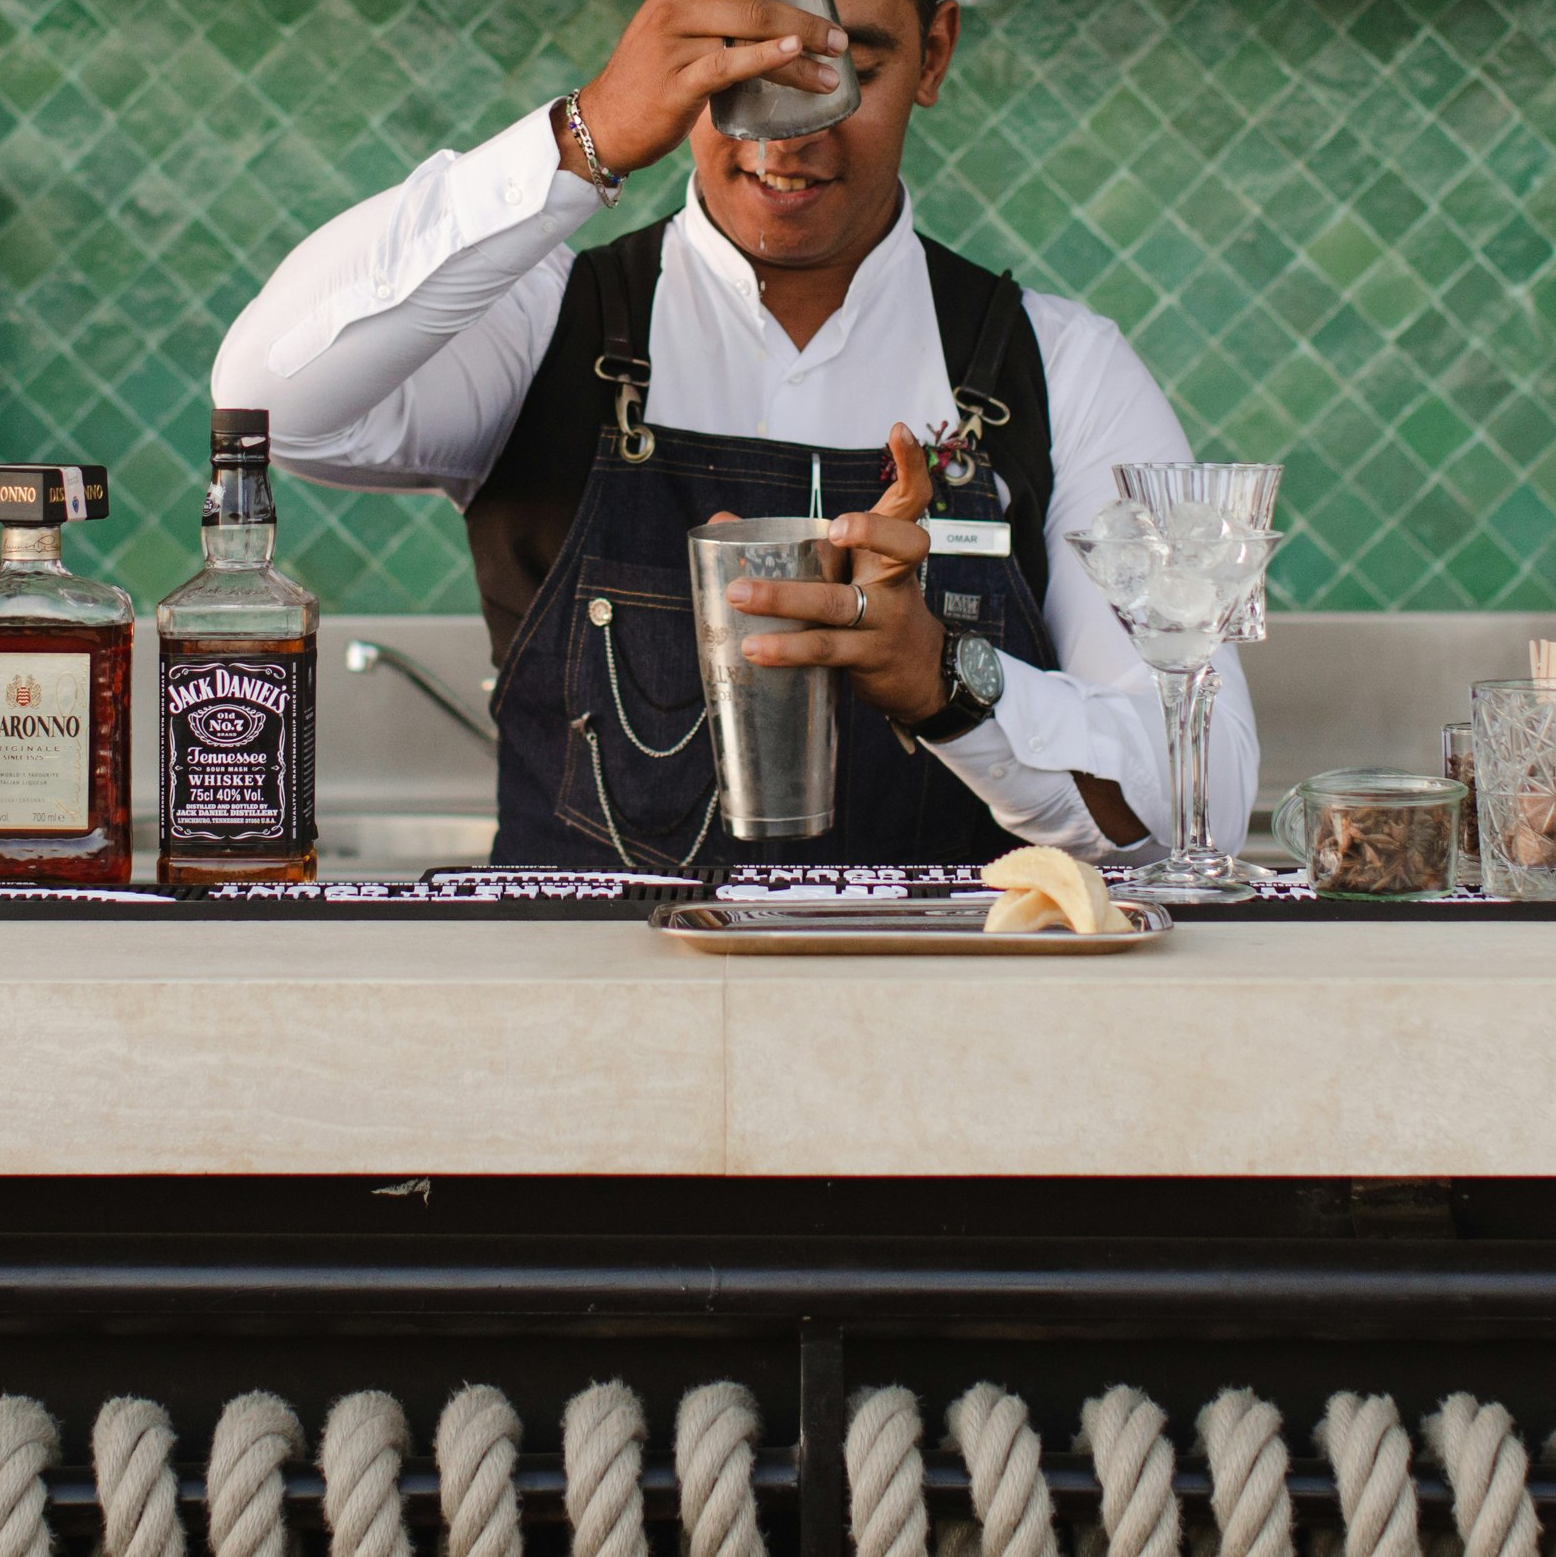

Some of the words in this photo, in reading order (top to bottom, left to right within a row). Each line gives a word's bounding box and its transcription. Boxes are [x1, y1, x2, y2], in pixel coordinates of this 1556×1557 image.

[49, 484, 104, 503] DISNNO
[946, 534, 978, 543] OMAR
[167, 675, 216, 714] JACK
[215, 668, 291, 714] DANIEL'S
[217, 712, 235, 720] Old
[208, 719, 244, 732] No.7
[187, 746, 267, 765] Tennessee
[188, 774, 266, 786] WHISKEY
[190, 788, 214, 801] 75cl
[216, 788, 241, 801] 40%
[244, 788, 265, 801] Vol.
[32, 812, 46, 822] 700
[48, 812, 56, 822] ml
[230, 809, 278, 817] DISTILLERY
